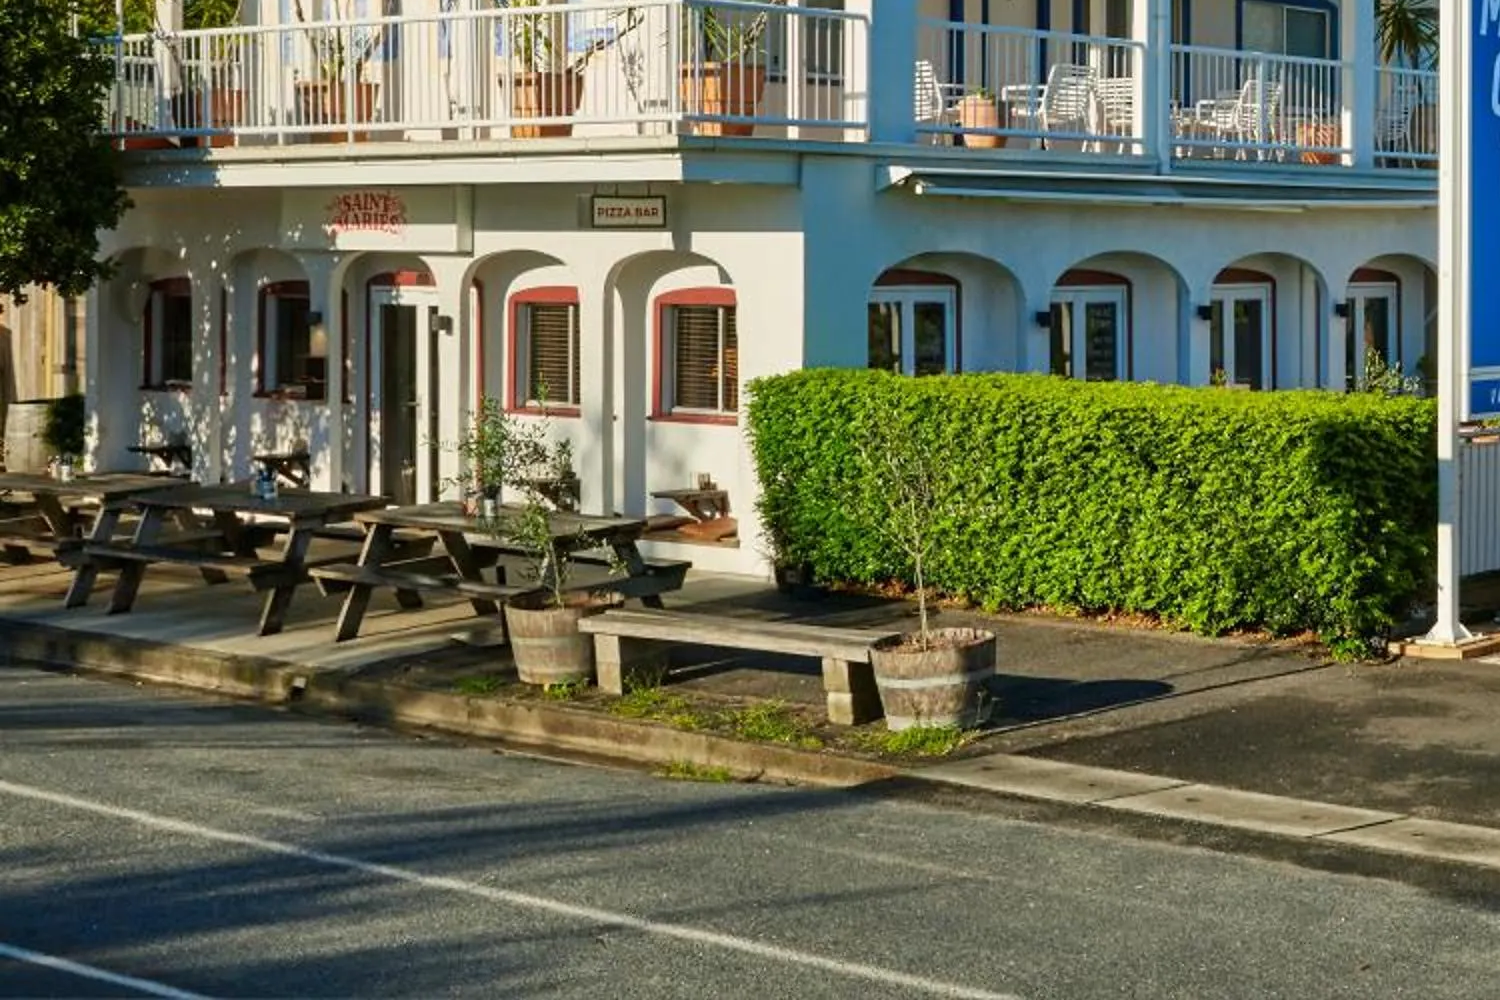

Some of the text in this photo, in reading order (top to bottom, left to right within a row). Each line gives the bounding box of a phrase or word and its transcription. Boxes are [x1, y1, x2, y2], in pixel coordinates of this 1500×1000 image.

[341, 192, 391, 213] SAINT
[597, 207, 659, 217] PIZZA BAR
